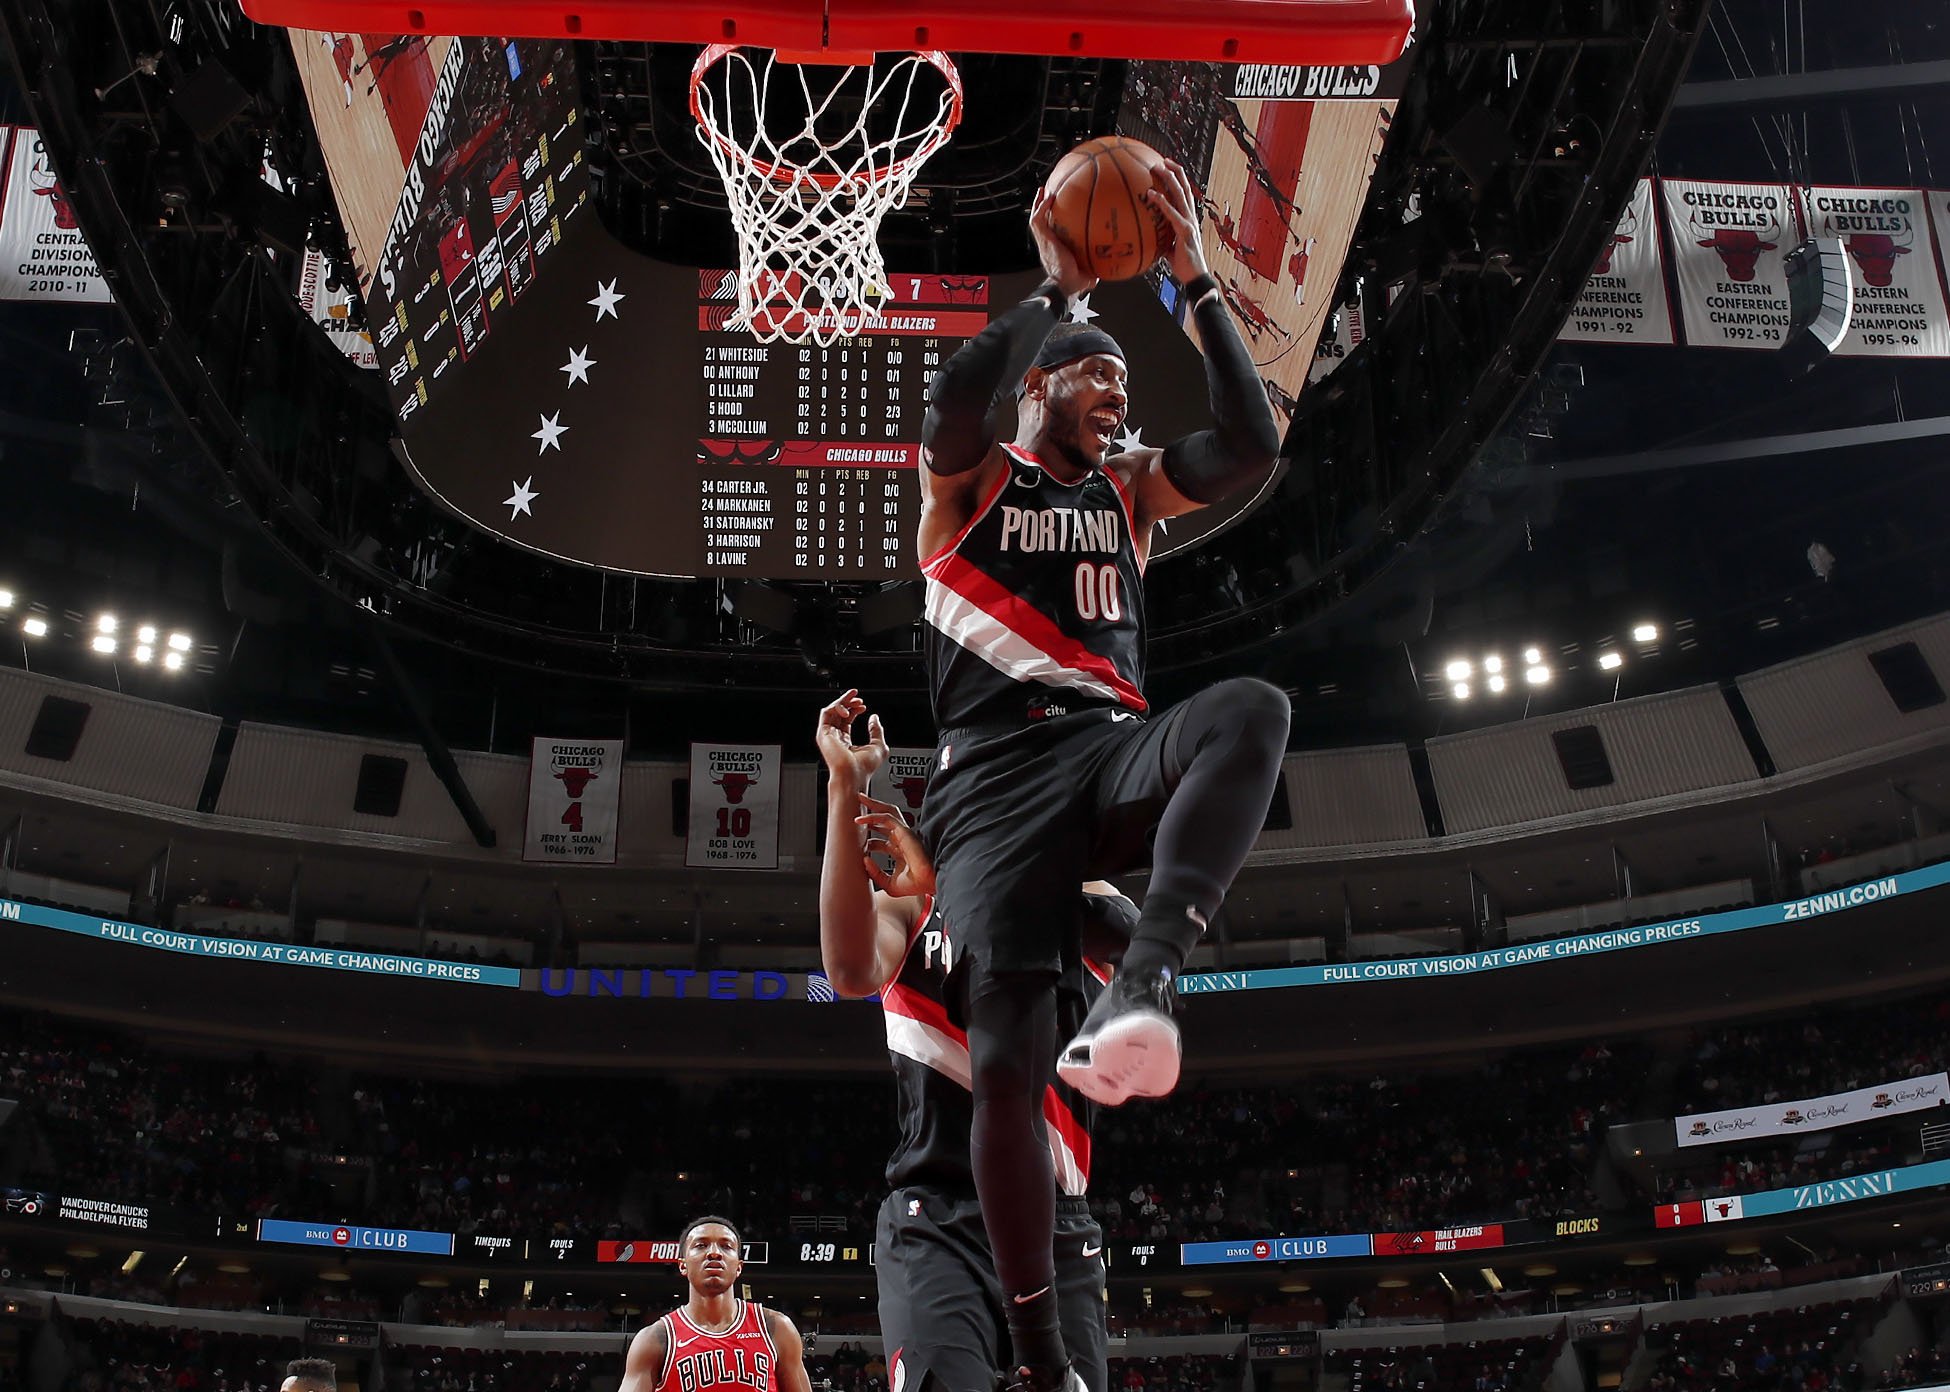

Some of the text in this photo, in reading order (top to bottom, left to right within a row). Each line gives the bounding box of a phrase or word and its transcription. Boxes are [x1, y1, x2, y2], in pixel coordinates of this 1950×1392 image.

[1234, 63, 1381, 97] CHICAGO BULLS
[421, 36, 464, 167] CHICAGO
[1683, 191, 1778, 210] CHICAGO
[1817, 197, 1910, 214] CHICAGO
[1701, 210, 1768, 227] BULLS
[1835, 215, 1901, 231] BULLS
[380, 159, 425, 303] BULLS
[36, 233, 88, 245] CENTRA
[31, 249, 94, 261] DIVISION
[477, 236, 502, 289] 8:39
[18, 264, 101, 277] CHAMPIONS
[911, 279, 921, 300] 7
[1587, 277, 1626, 289] STERN
[1716, 283, 1772, 295] EASTERN
[1580, 291, 1643, 304] NFERENCE
[1854, 287, 1909, 298] EASTERN
[1706, 297, 1788, 310] CONFERENCE
[1853, 303, 1926, 314] ONFERENCE
[1571, 306, 1644, 318] HAMPIONS
[1710, 312, 1789, 326] CHAMPIONS
[861, 316, 888, 329] RAIL
[891, 317, 936, 330] BLAZERS
[1576, 321, 1634, 333] 1991-92
[1723, 327, 1780, 340] 1992-93
[1862, 334, 1918, 345] 1995-96
[858, 338, 873, 347] REB
[706, 347, 715, 360] 21
[718, 347, 768, 362] WHITESIDE
[704, 366, 715, 379] 00
[718, 366, 759, 380] ANTHONY
[710, 384, 715, 397] 0
[718, 384, 753, 398] LILLARD
[709, 402, 715, 415] 5
[718, 402, 742, 416] HOOD
[709, 420, 715, 433] 3
[717, 420, 766, 434] MCCOLLUM
[826, 448, 907, 463] CHICAGO BULLS
[796, 469, 897, 480] MIN PTS REB FG
[702, 481, 713, 493] 34
[716, 481, 751, 494] CARTER
[702, 499, 713, 511] 24
[716, 499, 770, 512] MARKKANEN
[704, 516, 713, 529] 31
[716, 516, 773, 530] SATORANSKY
[708, 534, 713, 547] 3
[716, 534, 760, 548] HARRISON
[707, 552, 713, 565] 8
[716, 552, 746, 566] LAVINE
[1075, 562, 1121, 621] 00
[552, 745, 605, 756] CHICAGO
[709, 751, 762, 762] CHICAGO
[558, 757, 597, 767] BULLS
[717, 763, 755, 772] BULLS
[889, 756, 931, 766] CHICA
[561, 802, 583, 832] 4
[716, 808, 751, 838] 10
[540, 834, 601, 844] JERRY SLOAN
[709, 840, 755, 848] BOB LOVE
[1783, 878, 1897, 920] ZENNI.COM
[101, 922, 481, 980] FULL COURT VISION AT GAME CHANGING PRICES
[1178, 920, 1701, 993] ENNI FULL COURT VISION AT GAME CHANGING PRICES
[540, 966, 789, 1000] UNITED
[1794, 1173, 1894, 1208] ZENNI
[61, 1196, 149, 1218] VANCOUVER CANUCKS
[59, 1208, 148, 1229] PHILADELPHIA FLYERS
[1434, 1226, 1483, 1241] TRAIL BLAZERS
[1556, 1218, 1600, 1236] BLOCKS
[306, 1230, 408, 1248] BMO CLUB
[474, 1236, 574, 1249] TIMEOUTS FOULS
[1435, 1240, 1456, 1251] BULLS
[489, 1247, 564, 1260] 7 2
[650, 1243, 681, 1260] PORT
[743, 1244, 751, 1261] 7
[800, 1243, 835, 1262] 8:39
[1131, 1245, 1155, 1256] FOULS
[1226, 1240, 1328, 1257] BMO CLUB
[1140, 1255, 1147, 1266] 0
[676, 1349, 770, 1392] BULLS
